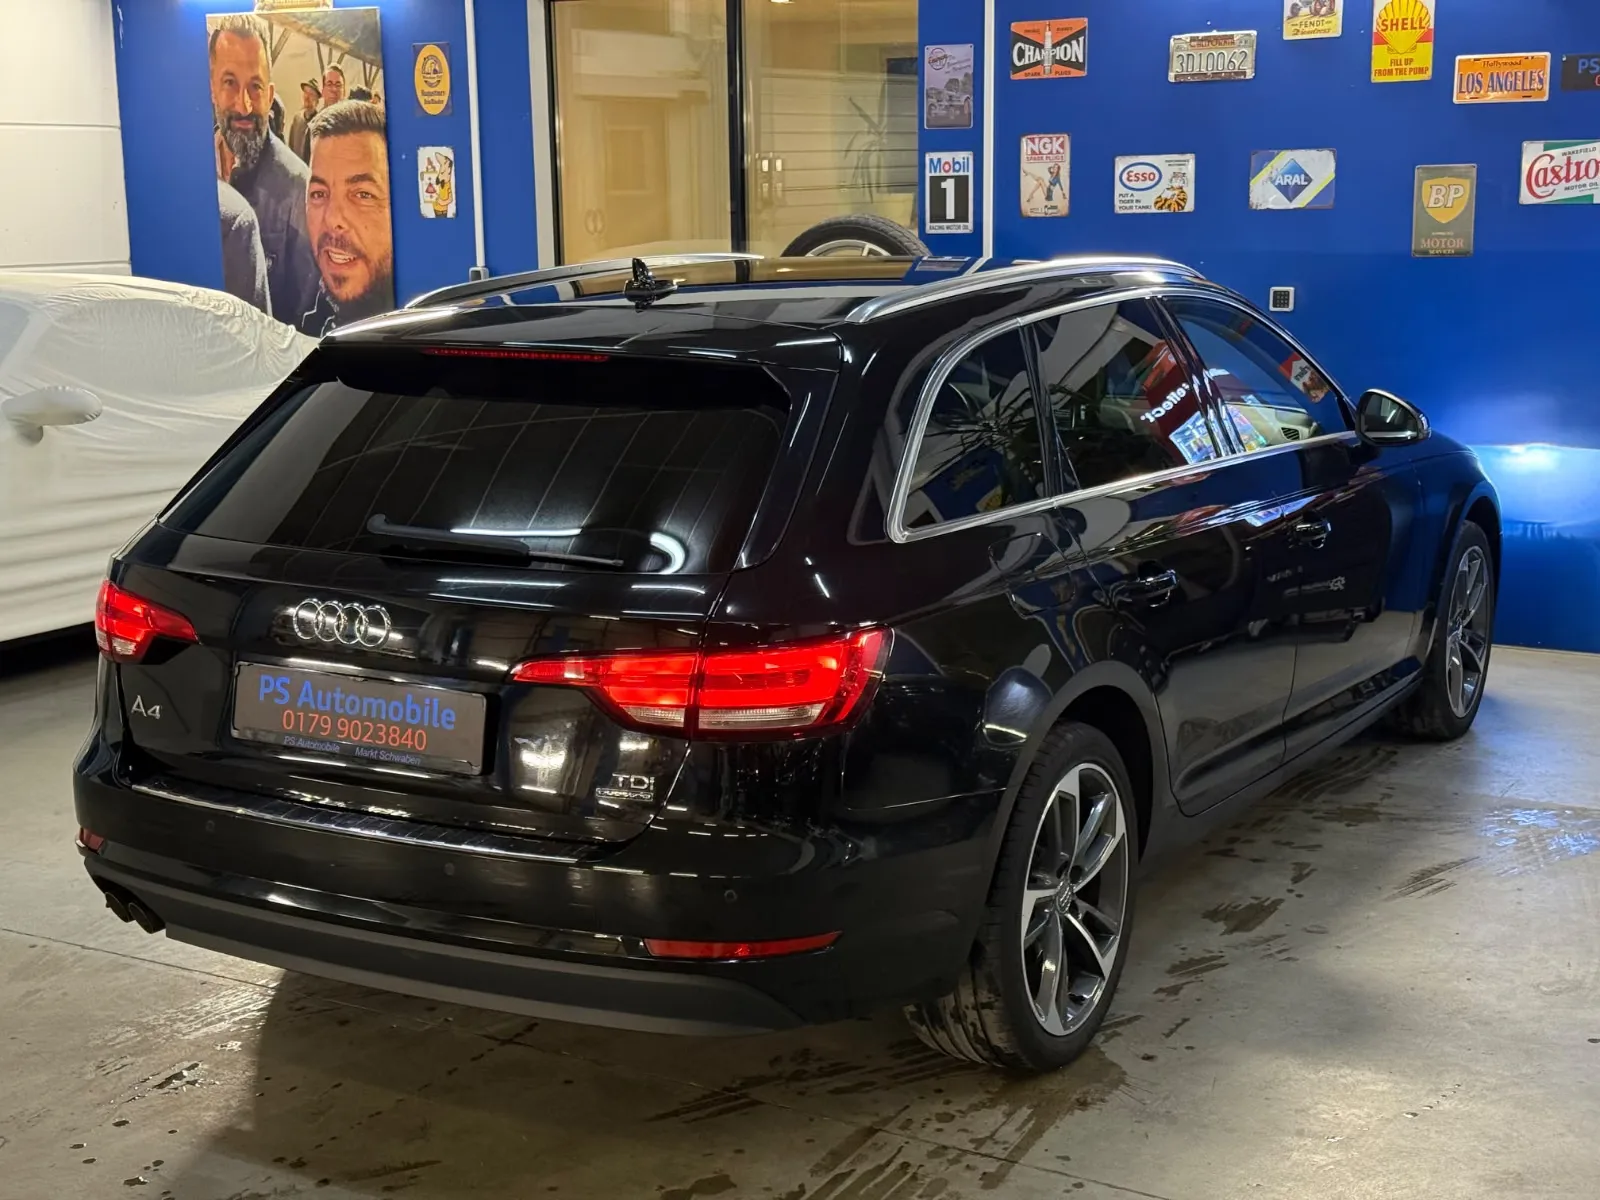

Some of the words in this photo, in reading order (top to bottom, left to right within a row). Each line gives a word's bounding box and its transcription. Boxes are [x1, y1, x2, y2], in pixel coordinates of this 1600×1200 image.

[1299, 19, 1326, 28] FENDT
[1381, 16, 1426, 32] SHELL
[1012, 35, 1085, 67] CHAMPION
[1389, 58, 1403, 67] FILL
[1404, 57, 1414, 66] UP
[1482, 59, 1522, 69] Hollywood
[1373, 68, 1394, 77] FROM
[1394, 67, 1408, 76] THE
[1408, 66, 1430, 75] PUMP
[1458, 71, 1483, 94] LOS
[1486, 70, 1545, 93] ANGELES
[1026, 137, 1065, 155] NGK
[1561, 146, 1597, 157] WAKEFIELD
[929, 156, 969, 174] Mobil
[1274, 173, 1309, 186] ARAL
[1526, 153, 1600, 200] Castro
[1564, 183, 1588, 191] MOTOR
[940, 178, 955, 220] 1
[1426, 184, 1465, 209] BP
[1420, 237, 1464, 249] MOTOR
[130, 694, 161, 719] A4
[259, 674, 290, 705] PS
[297, 680, 457, 730] Automobile
[282, 709, 333, 736] 0179
[337, 717, 428, 751] 9023840
[297, 737, 341, 753] Automobile
[355, 747, 378, 759] Markt
[379, 749, 422, 766] Schwaben
[612, 772, 656, 791] TDI
